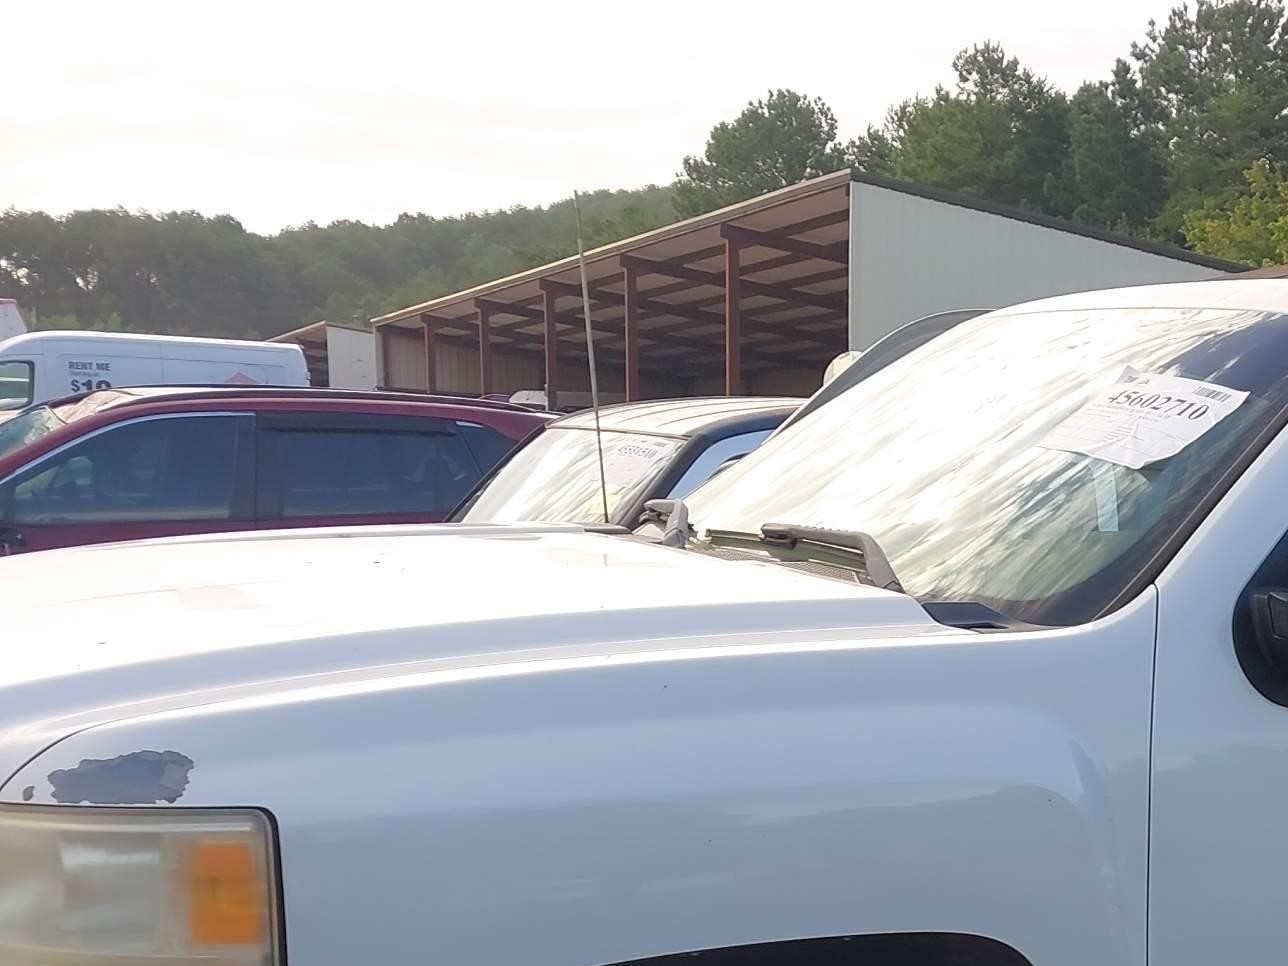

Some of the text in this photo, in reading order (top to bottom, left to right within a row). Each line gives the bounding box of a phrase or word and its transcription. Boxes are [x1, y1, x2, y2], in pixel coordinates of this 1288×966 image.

[68, 361, 111, 371] RENT ME
[1107, 389, 1210, 421] 45602710
